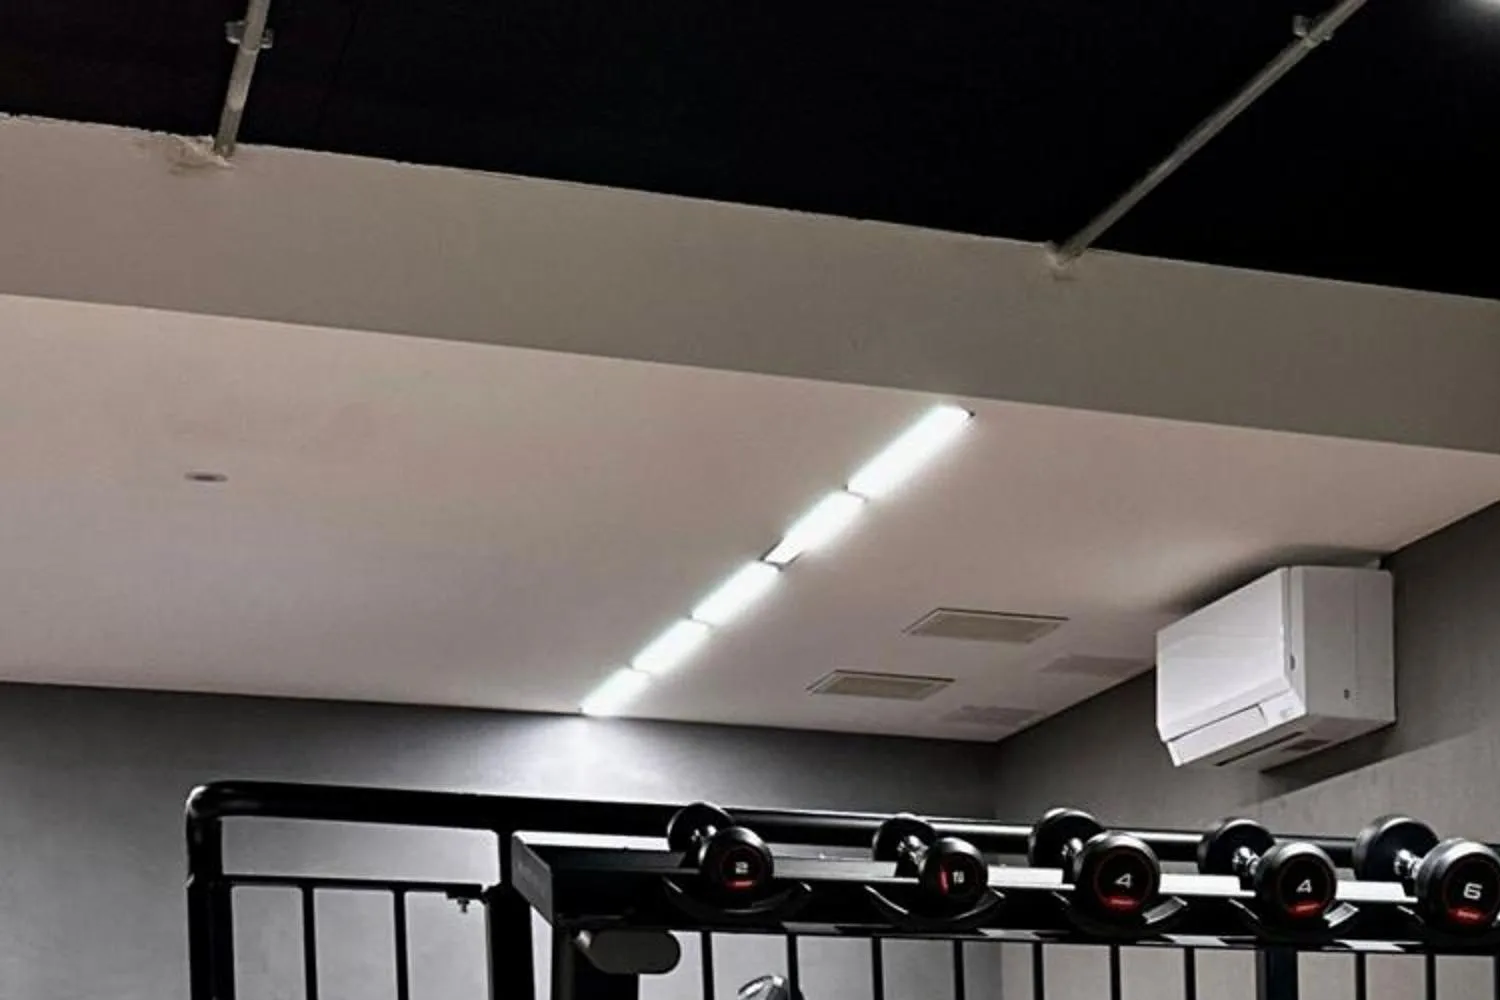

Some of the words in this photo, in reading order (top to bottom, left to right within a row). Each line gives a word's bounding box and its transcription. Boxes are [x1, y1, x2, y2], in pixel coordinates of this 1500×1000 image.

[1115, 873, 1132, 888] 4
[1296, 879, 1313, 893] 4
[1463, 882, 1483, 899] 6
